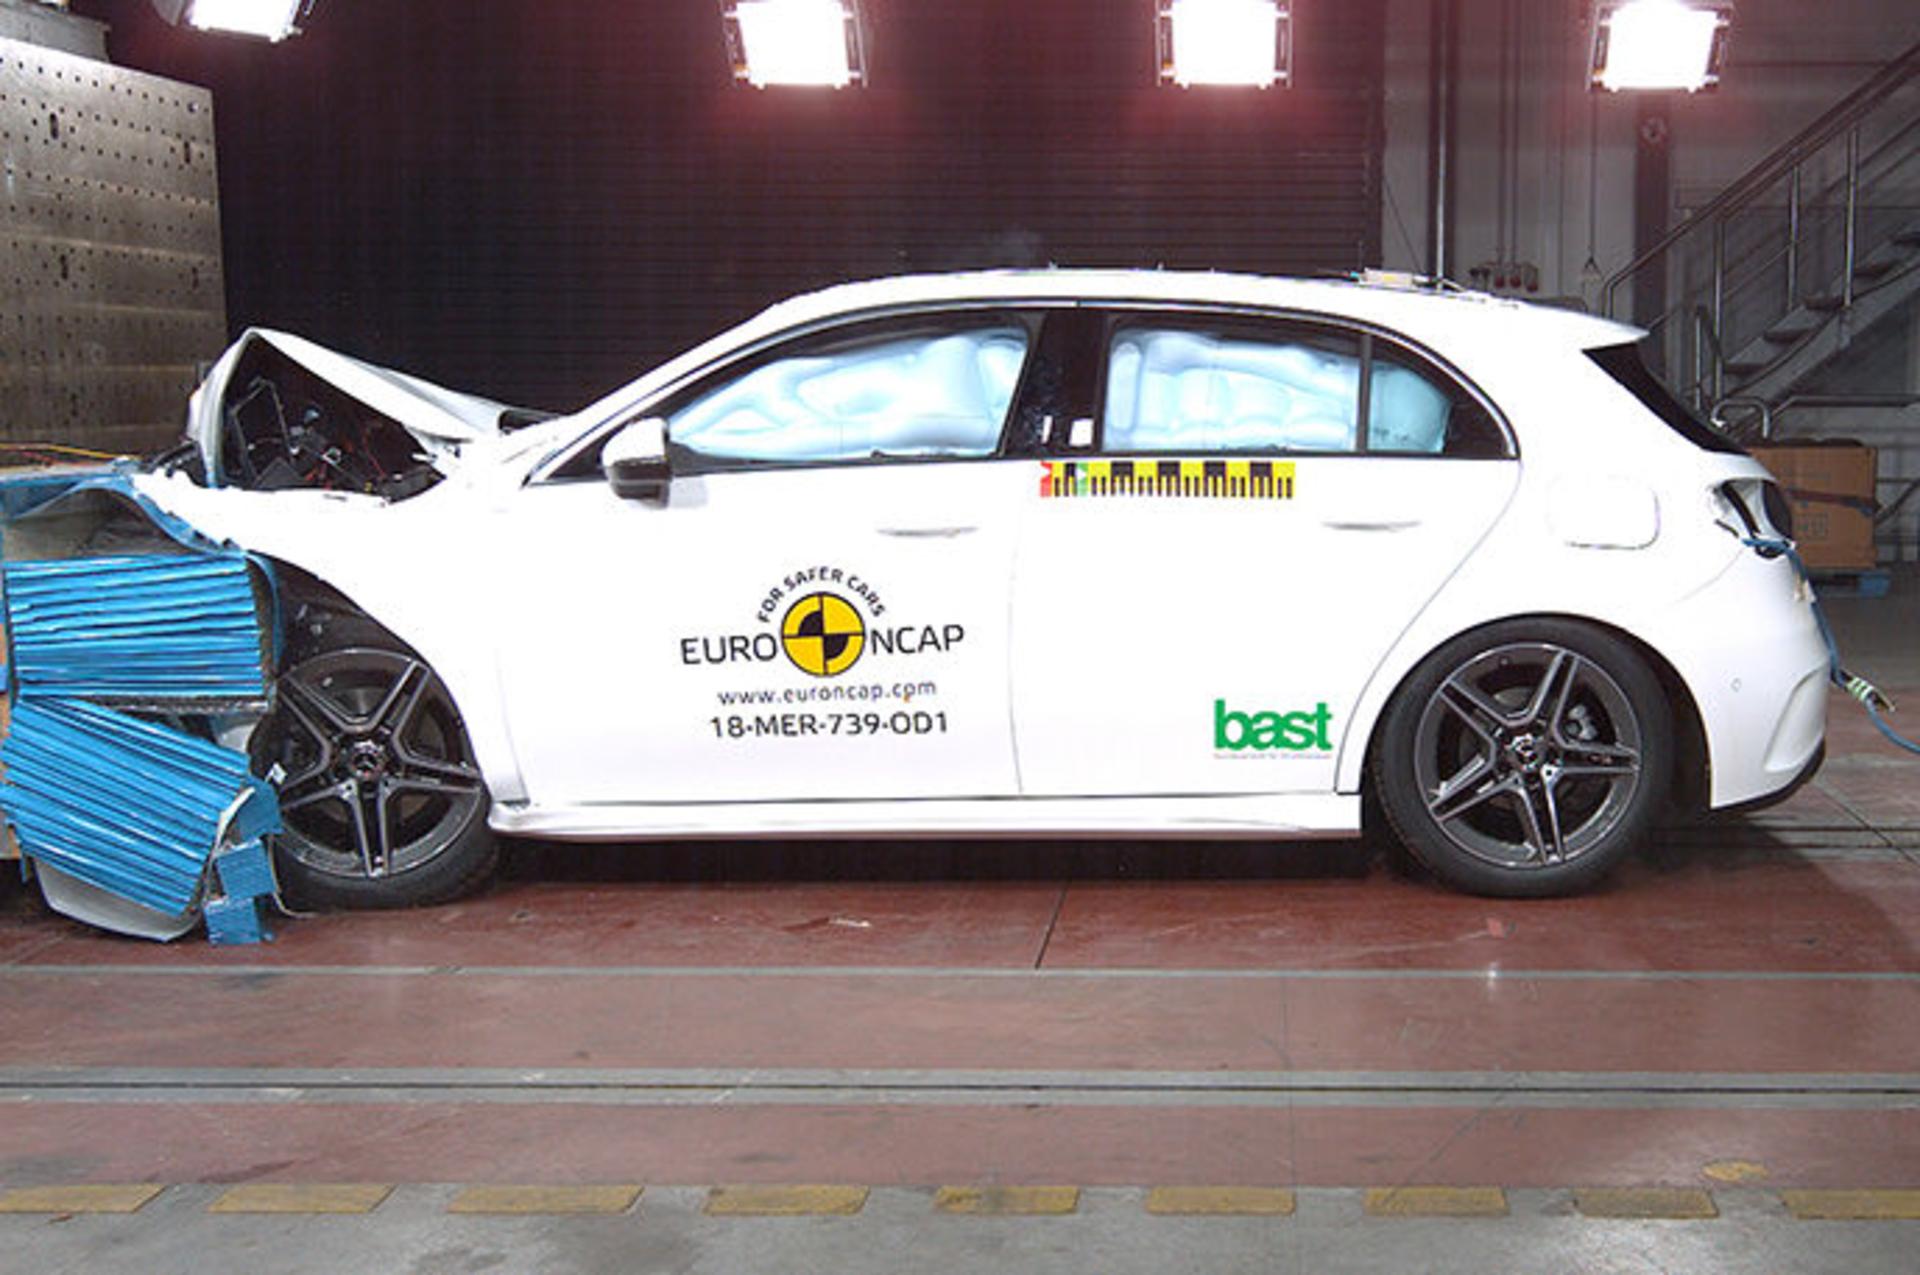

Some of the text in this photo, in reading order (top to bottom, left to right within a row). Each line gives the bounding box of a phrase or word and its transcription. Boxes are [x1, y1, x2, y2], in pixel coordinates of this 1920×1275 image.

[757, 566, 887, 623] FOR SAFER CARS
[680, 624, 965, 665] EURO NCAP
[716, 680, 938, 705] www.euroncap.com
[1214, 699, 1333, 751] bast
